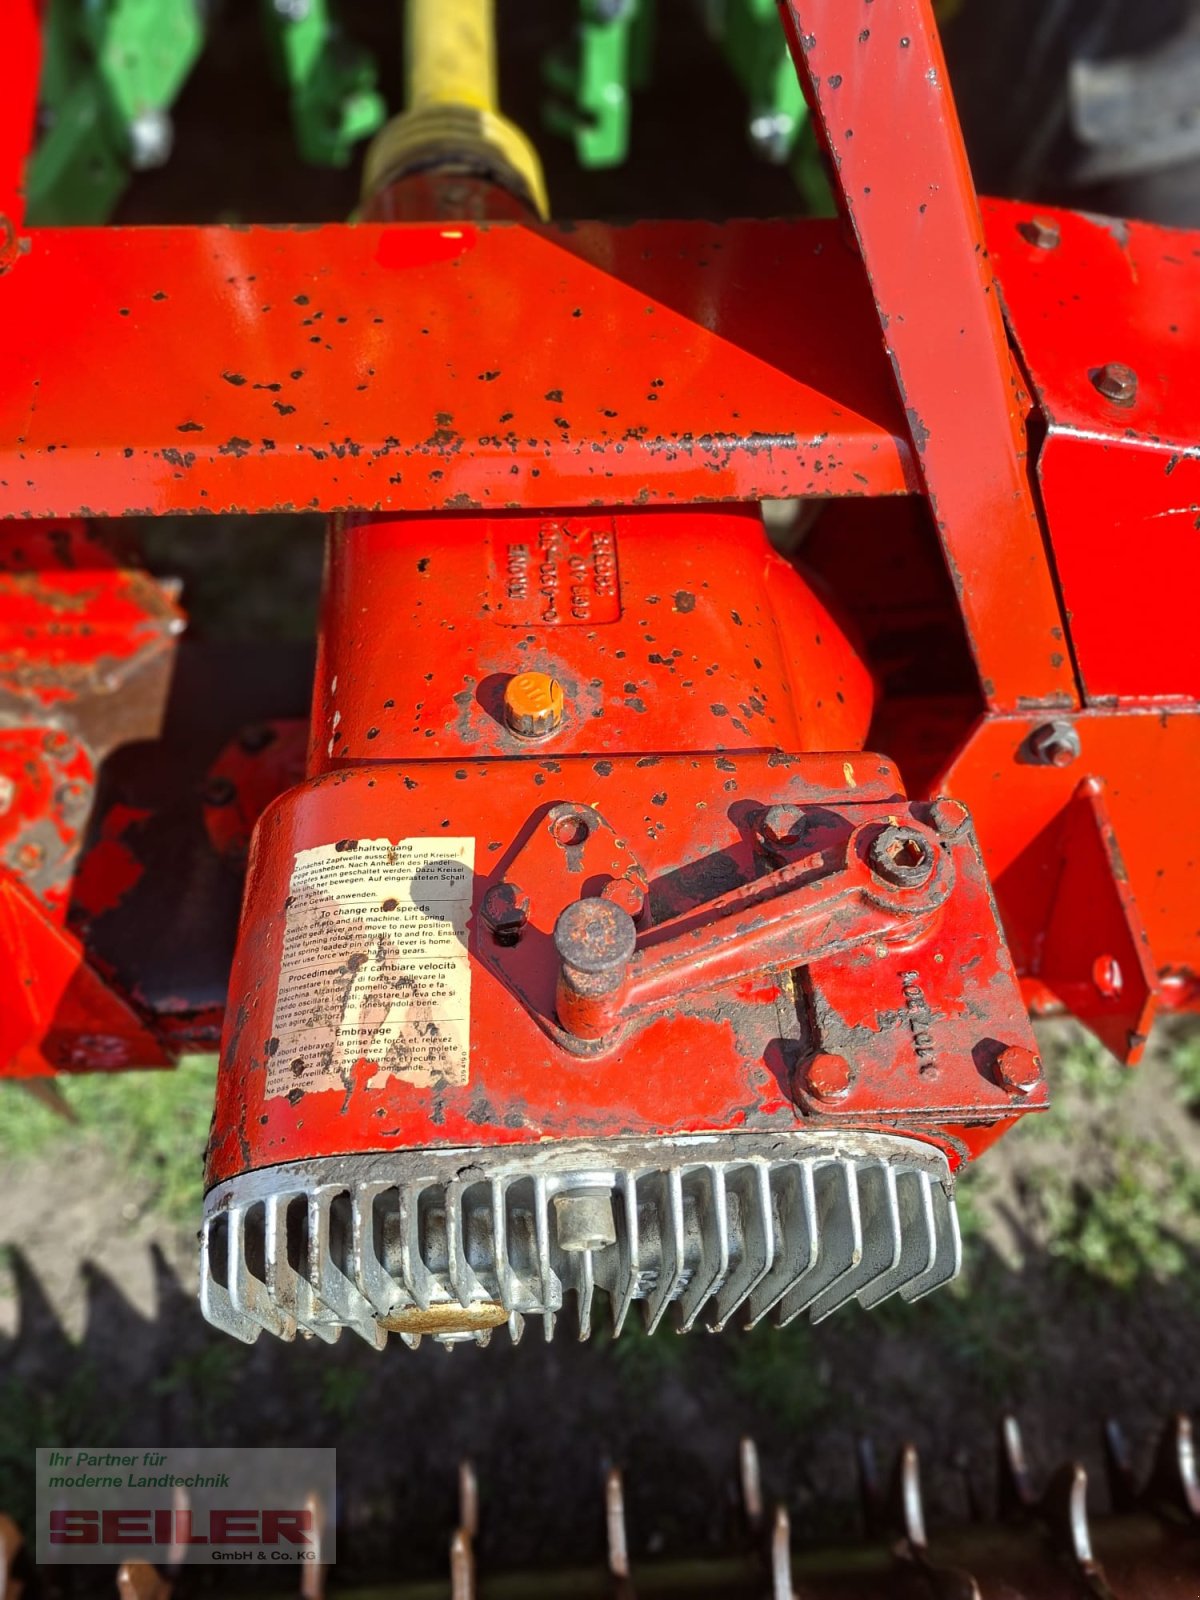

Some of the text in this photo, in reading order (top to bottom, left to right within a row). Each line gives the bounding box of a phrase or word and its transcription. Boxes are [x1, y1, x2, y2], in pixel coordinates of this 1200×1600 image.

[326, 855, 362, 865] Zapfwelle
[340, 869, 379, 877] geschaltet
[330, 877, 365, 885] bewegen.
[310, 895, 334, 904] Gewalt
[336, 892, 377, 900] anwenden.
[320, 910, 330, 918] To
[333, 907, 367, 915] change
[298, 947, 319, 956] spring
[283, 959, 300, 968] Never
[317, 952, 336, 960] force
[371, 963, 415, 971] cambiare
[418, 962, 456, 970] velocità
[279, 981, 321, 994] Disinnestare
[335, 1028, 391, 1036] Embrayage
[347, 1038, 367, 1047] prise
[344, 1047, 383, 1055] Soulevez
[277, 1084, 289, 1093] pas
